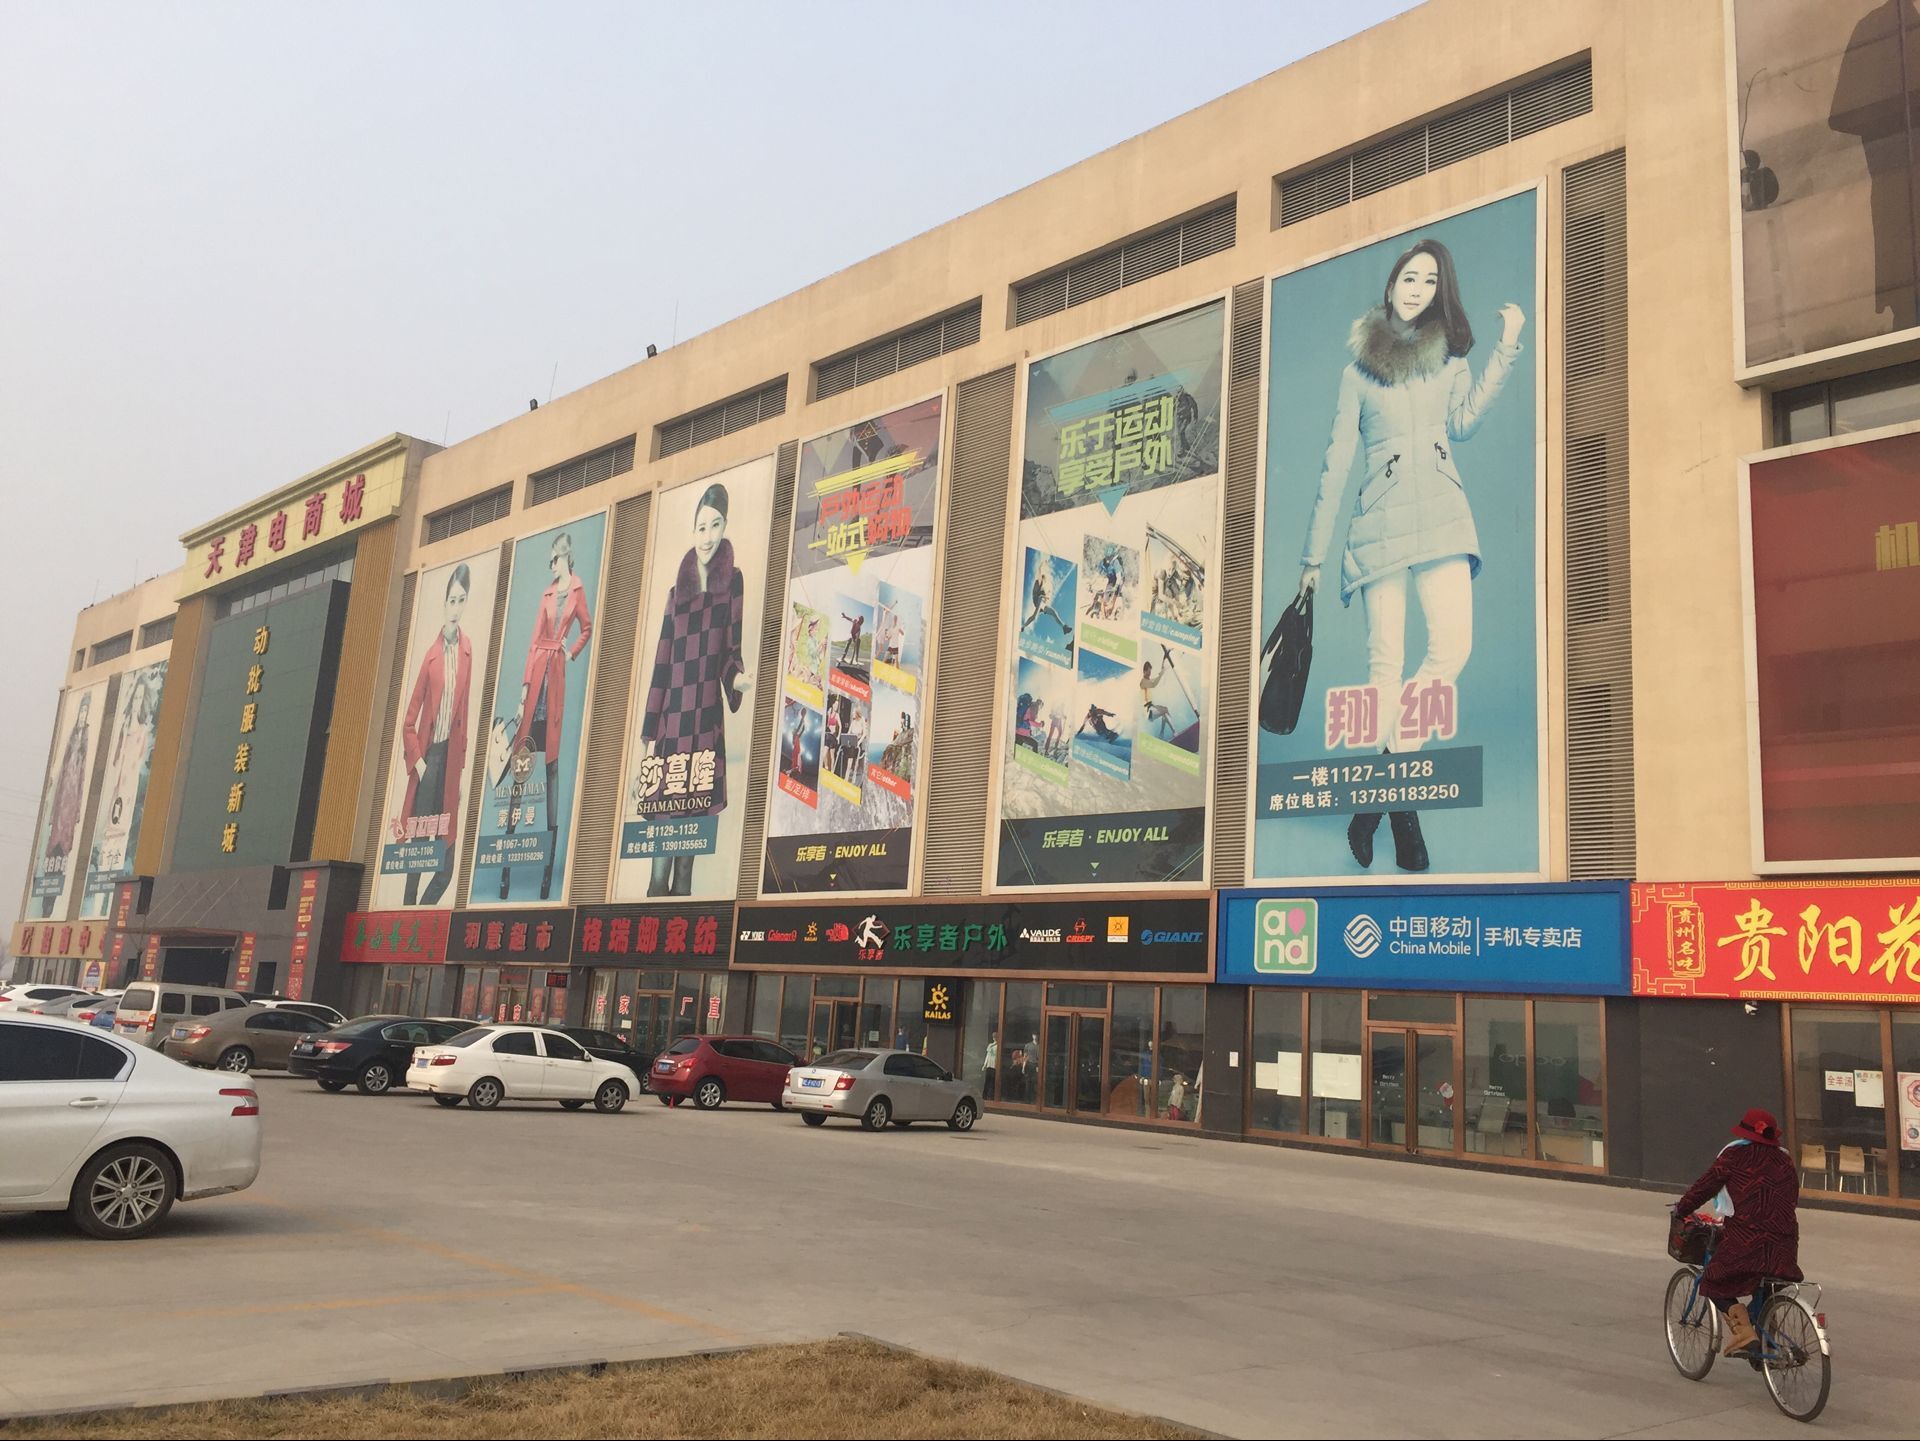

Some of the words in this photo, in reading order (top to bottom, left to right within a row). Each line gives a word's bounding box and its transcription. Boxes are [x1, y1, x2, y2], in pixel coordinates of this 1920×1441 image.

[1057, 435, 1174, 496] 享受户外
[818, 474, 905, 526] 户外运动
[204, 474, 367, 579] 天津电商城
[1328, 679, 1455, 747] 翔纳
[221, 625, 270, 853] 动批服装新城
[638, 749, 716, 797] 莎蔓隆
[1292, 760, 1434, 787] 一楼1127-1128
[637, 796, 712, 815] SHAMANLONG
[1350, 783, 1460, 805] 13736183250
[638, 823, 699, 839] 一楼1129-1132
[1042, 828, 1085, 849] 乐享者
[1096, 827, 1142, 845] ENJOY
[1144, 825, 1169, 842] ALL
[796, 844, 827, 862] 乐享者
[834, 843, 867, 860] ENJOY
[868, 840, 887, 857] ALL
[893, 922, 1008, 952] 乐享者户外
[1030, 928, 1062, 937] VAUDE
[1154, 931, 1204, 943] GIANT
[1389, 915, 1472, 939] 中国移动
[1484, 926, 1582, 949] 手机专卖店
[1389, 940, 1427, 956] China
[1428, 941, 1472, 956] Mobile
[1674, 908, 1696, 971] 贵州名吃
[857, 948, 884, 960] 乐享者
[924, 1011, 952, 1020] KAILAS
